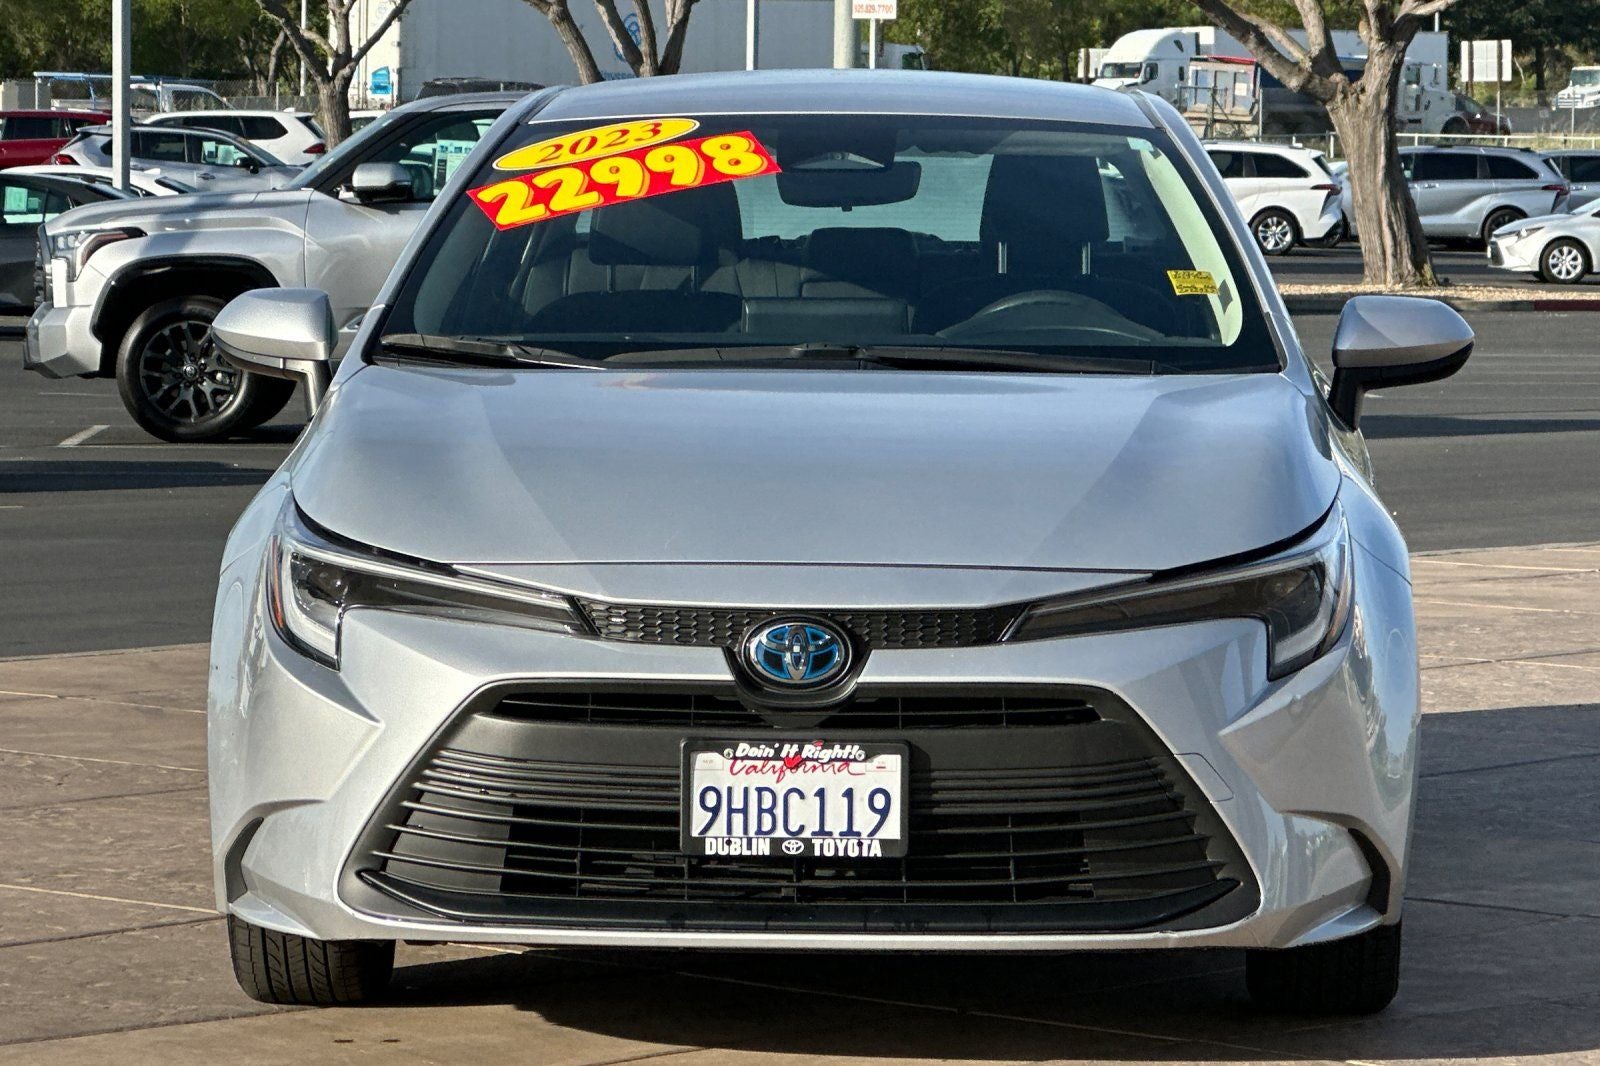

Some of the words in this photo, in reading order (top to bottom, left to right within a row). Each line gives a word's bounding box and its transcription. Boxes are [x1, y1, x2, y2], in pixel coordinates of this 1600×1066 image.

[537, 122, 663, 164] 2023
[477, 134, 769, 226] 22998
[736, 743, 779, 758] Doin'
[780, 743, 800, 758] It
[802, 743, 859, 764] Right!
[698, 785, 892, 838] 9HBC119
[704, 837, 771, 856] DUBLIN
[812, 838, 883, 858] TOYOTA
